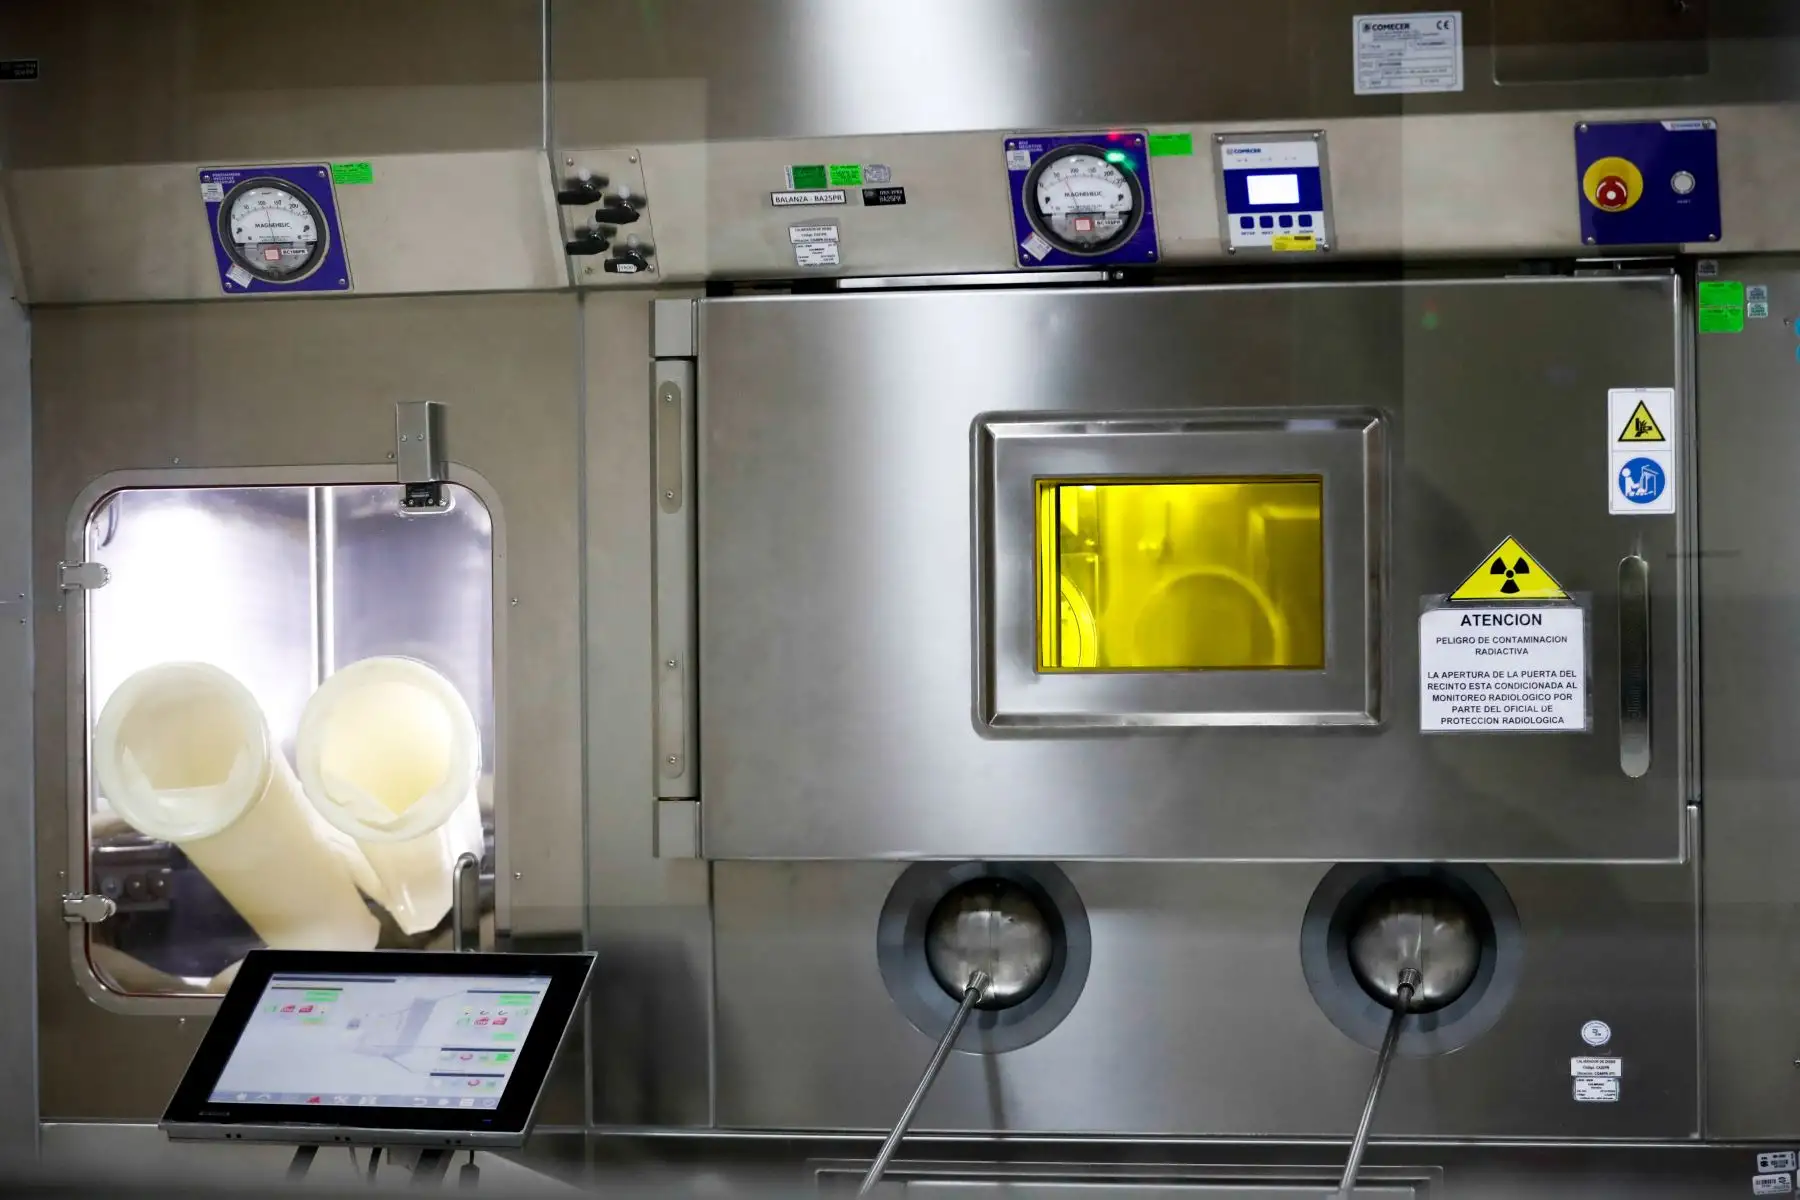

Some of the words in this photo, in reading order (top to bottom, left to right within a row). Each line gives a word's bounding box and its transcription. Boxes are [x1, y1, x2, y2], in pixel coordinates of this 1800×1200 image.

[1372, 23, 1410, 31] COMECER
[775, 195, 809, 204] BALANZA
[255, 221, 291, 229] MAGNEHELIC
[1460, 613, 1542, 627] ATENCION
[1436, 636, 1476, 645] PELIGRO
[1477, 636, 1490, 644] DE
[1493, 635, 1568, 644] CONTAMINACION
[1475, 647, 1529, 656] RADIACTIVA
[1427, 671, 1440, 679] LA
[1441, 671, 1491, 679] APERTURA
[1492, 671, 1505, 679] DE
[1520, 670, 1558, 679] PUERTA
[1559, 670, 1577, 678] DEL
[1427, 682, 1467, 691] RECINTO
[1468, 682, 1493, 691] ESTA
[1494, 682, 1564, 690] CONDICIONADA
[1565, 682, 1578, 690] AL
[1432, 694, 1487, 702] MONITOREO
[1488, 693, 1552, 702] RADIOLOGICO
[1553, 693, 1573, 701] POR
[1451, 705, 1482, 713] PARTE
[1483, 705, 1502, 713] DEL
[1503, 705, 1539, 713] OFICIAL
[1541, 704, 1553, 713] DE
[1440, 716, 1500, 725] PROTECCION
[1502, 716, 1565, 725] RADIOLOGICA
